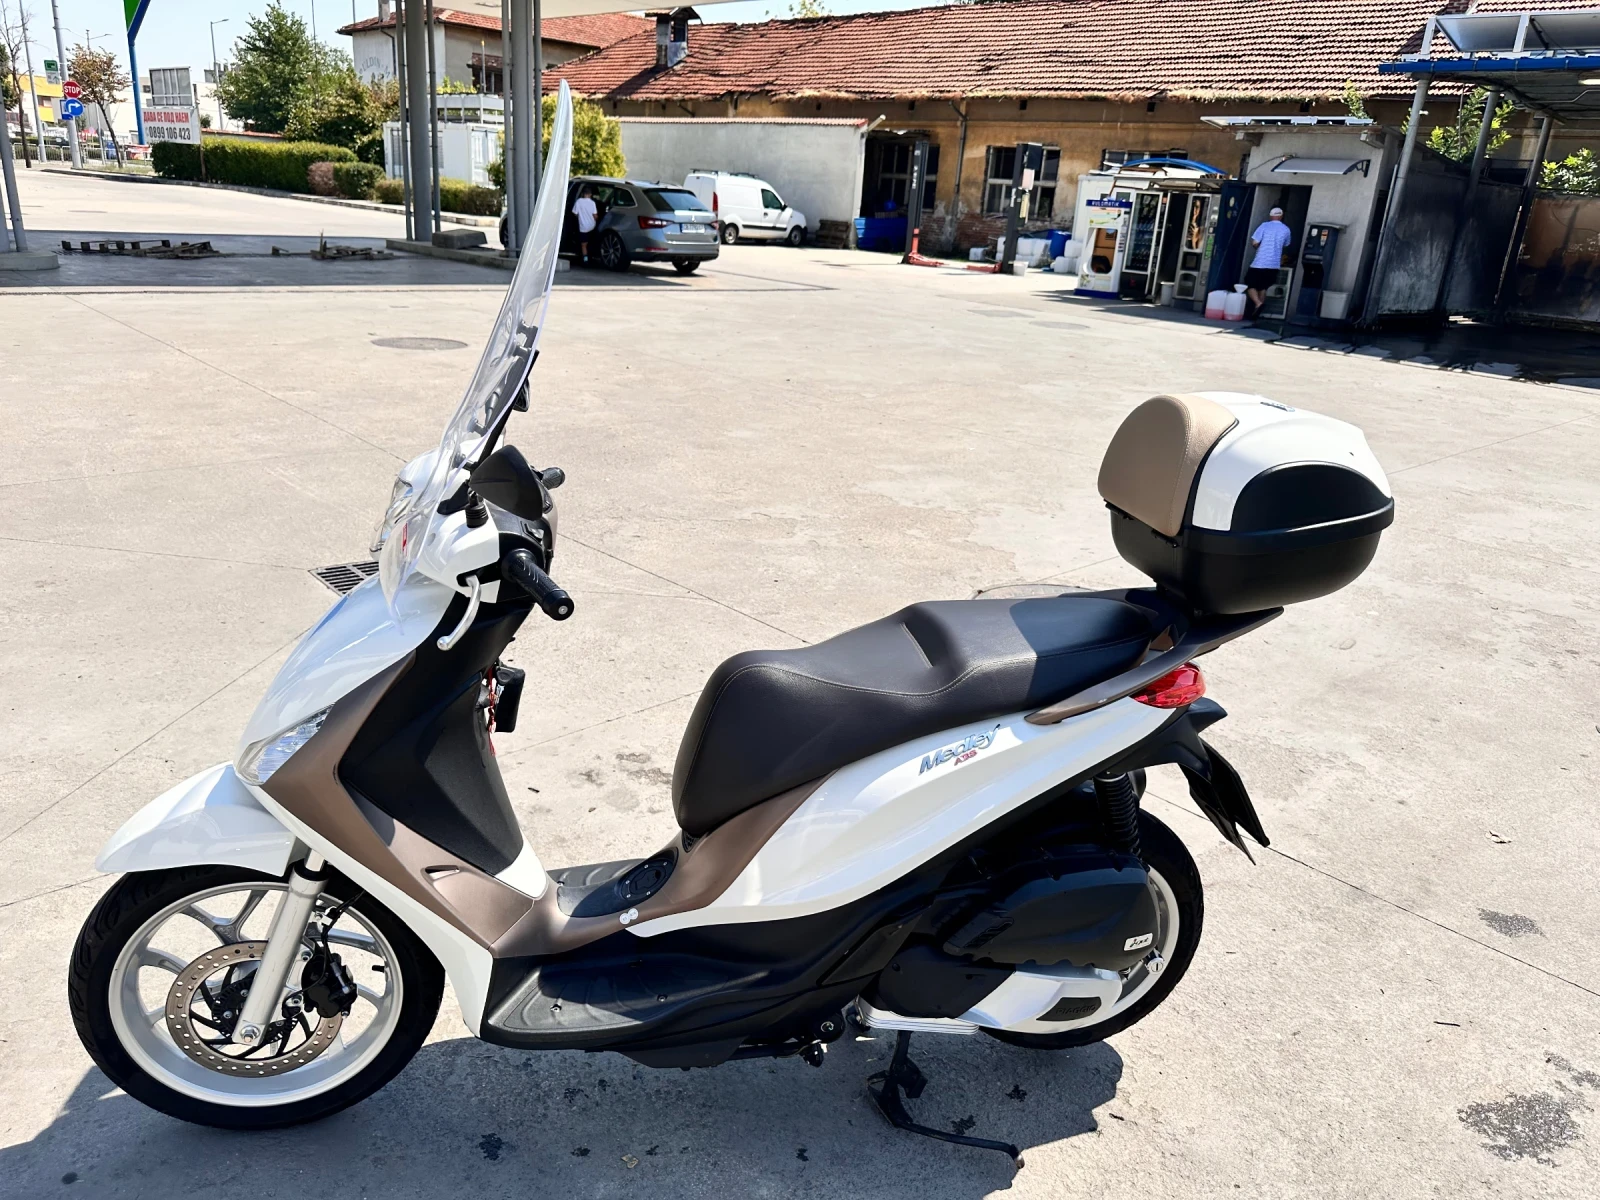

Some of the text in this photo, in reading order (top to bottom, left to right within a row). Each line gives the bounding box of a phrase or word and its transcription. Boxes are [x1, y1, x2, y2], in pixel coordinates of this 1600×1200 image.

[64, 85, 80, 94] STOP
[143, 112, 189, 124] ДАВА СЕ ПОД НАЕМ
[149, 126, 191, 140] 0899 106 423
[918, 724, 1000, 776] Medley
[954, 750, 977, 766] ABS
[1055, 1004, 1096, 1015] PIAGGIO
